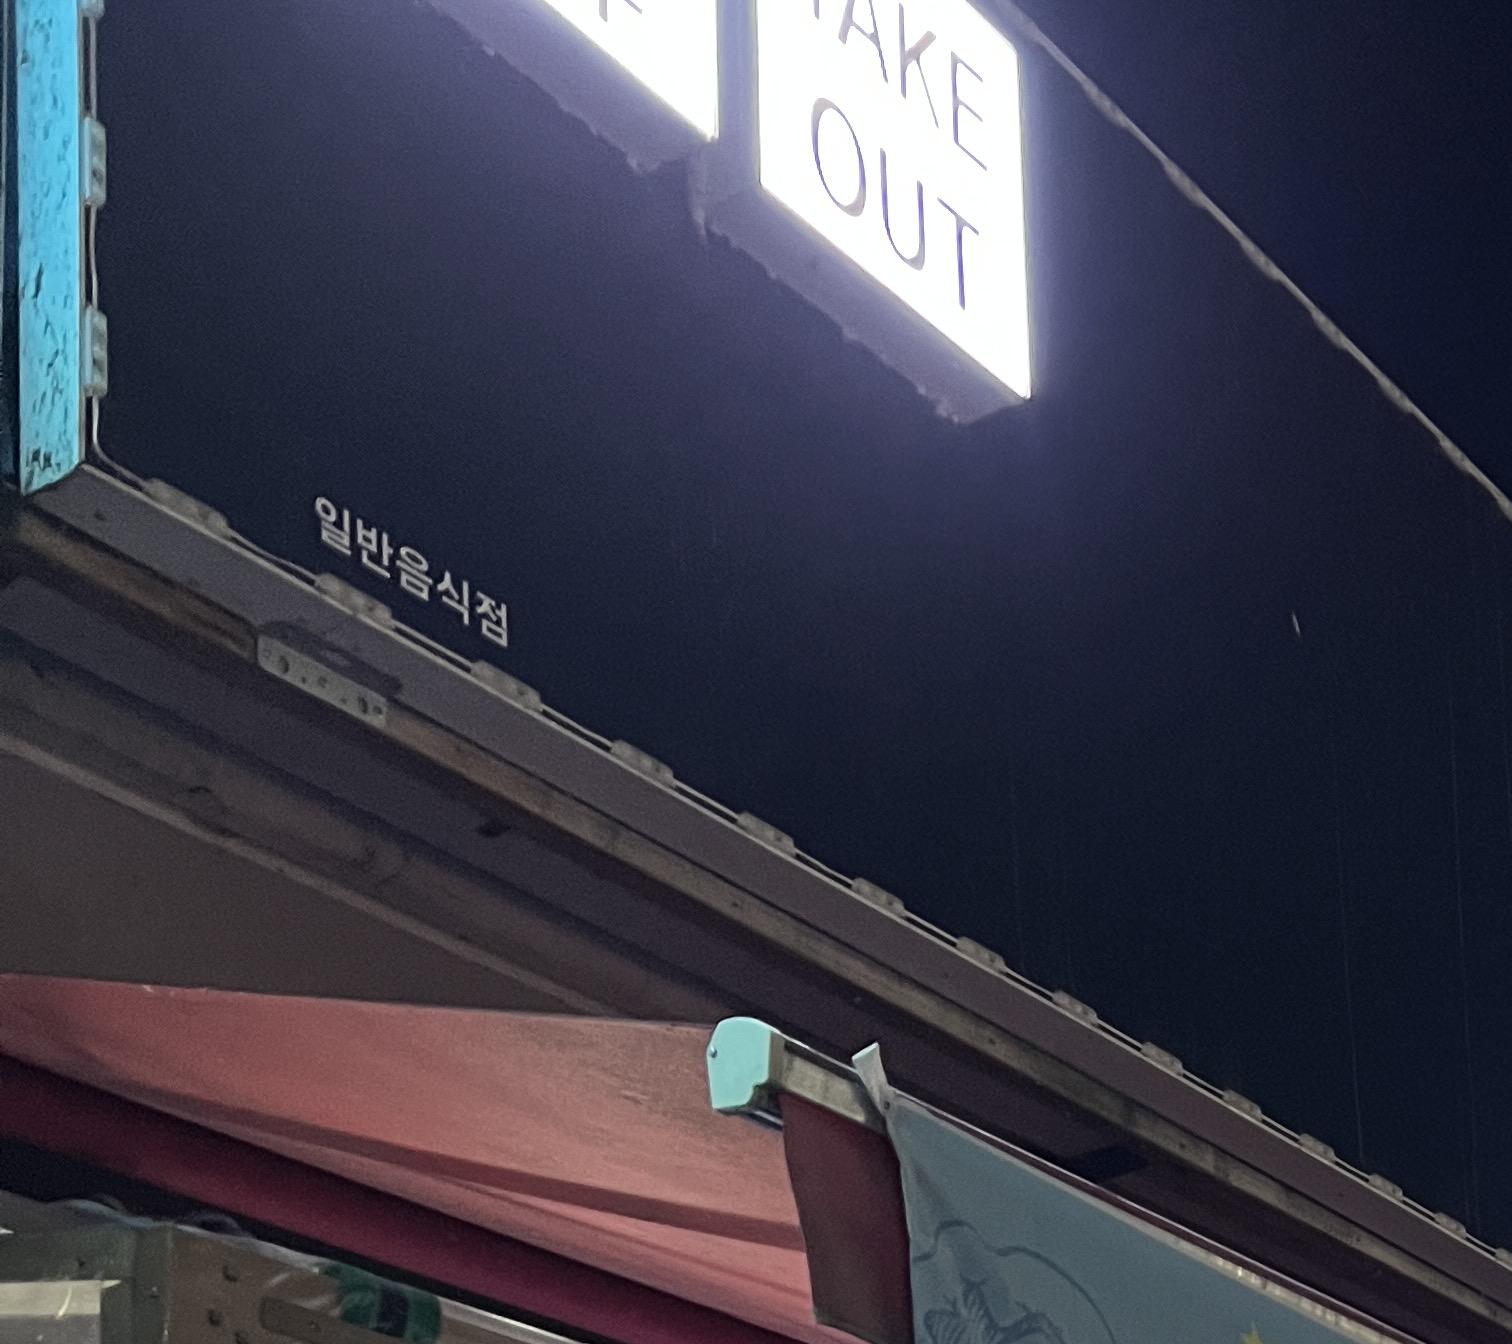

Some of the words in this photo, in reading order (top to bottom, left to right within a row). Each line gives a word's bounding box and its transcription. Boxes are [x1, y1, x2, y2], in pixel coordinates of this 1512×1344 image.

[812, 0, 987, 170] AKE
[811, 97, 980, 310] OUT
[314, 497, 508, 648] 일반음식점
